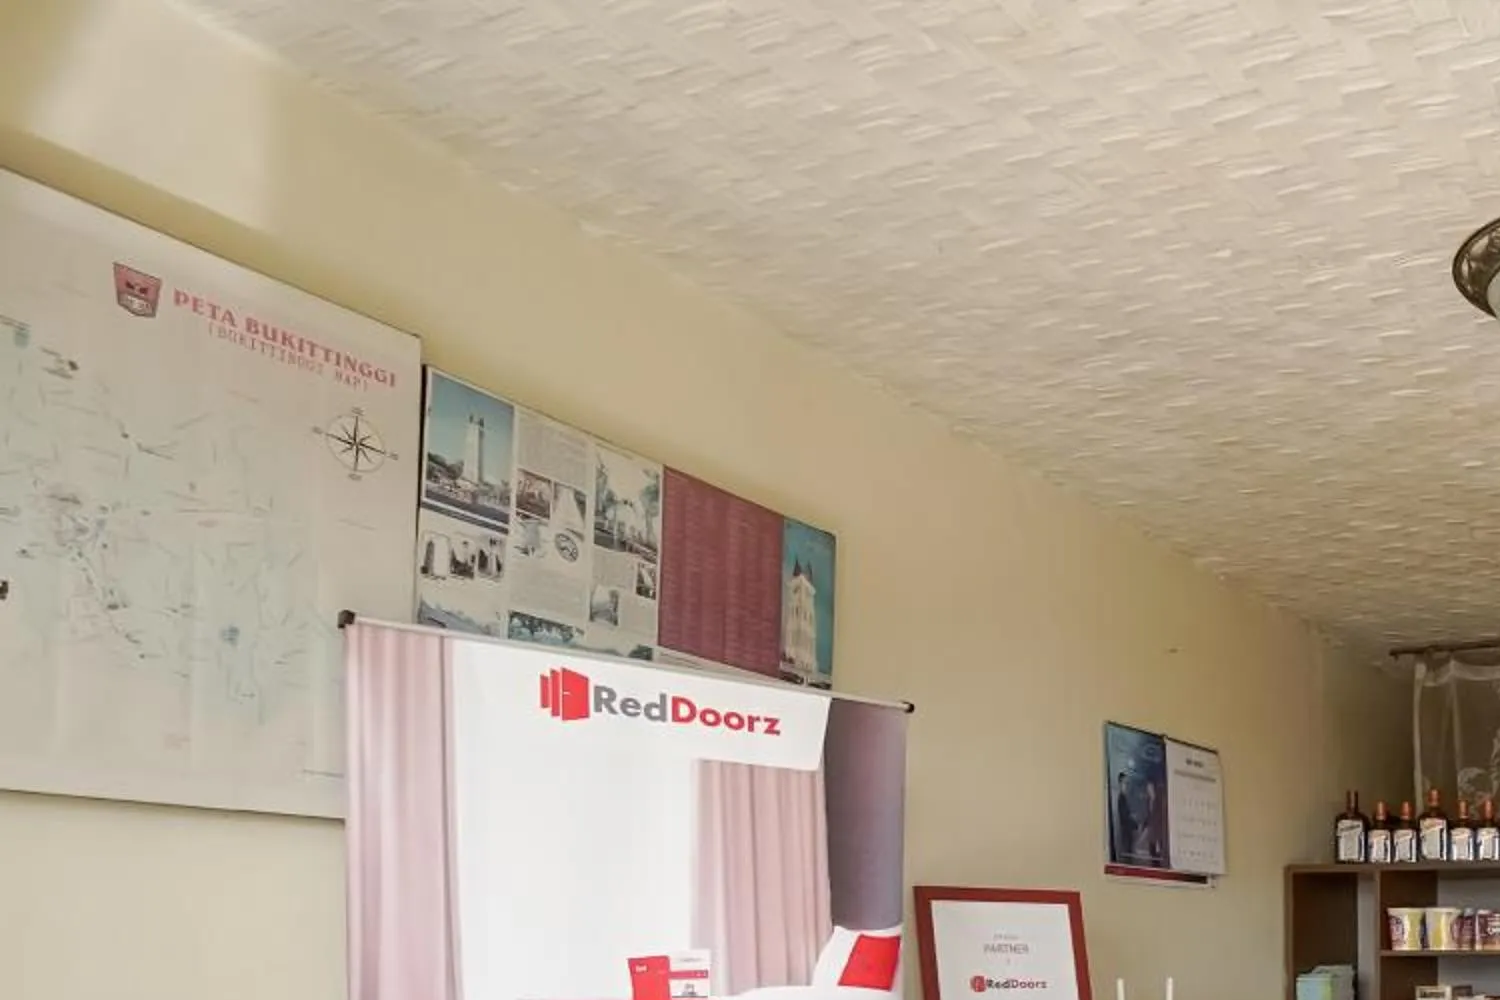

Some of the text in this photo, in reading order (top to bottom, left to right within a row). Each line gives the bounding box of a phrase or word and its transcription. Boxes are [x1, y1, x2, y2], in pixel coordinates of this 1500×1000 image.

[174, 287, 397, 388] PETA BUKITTINGGI
[593, 685, 781, 736] RedDoorz
